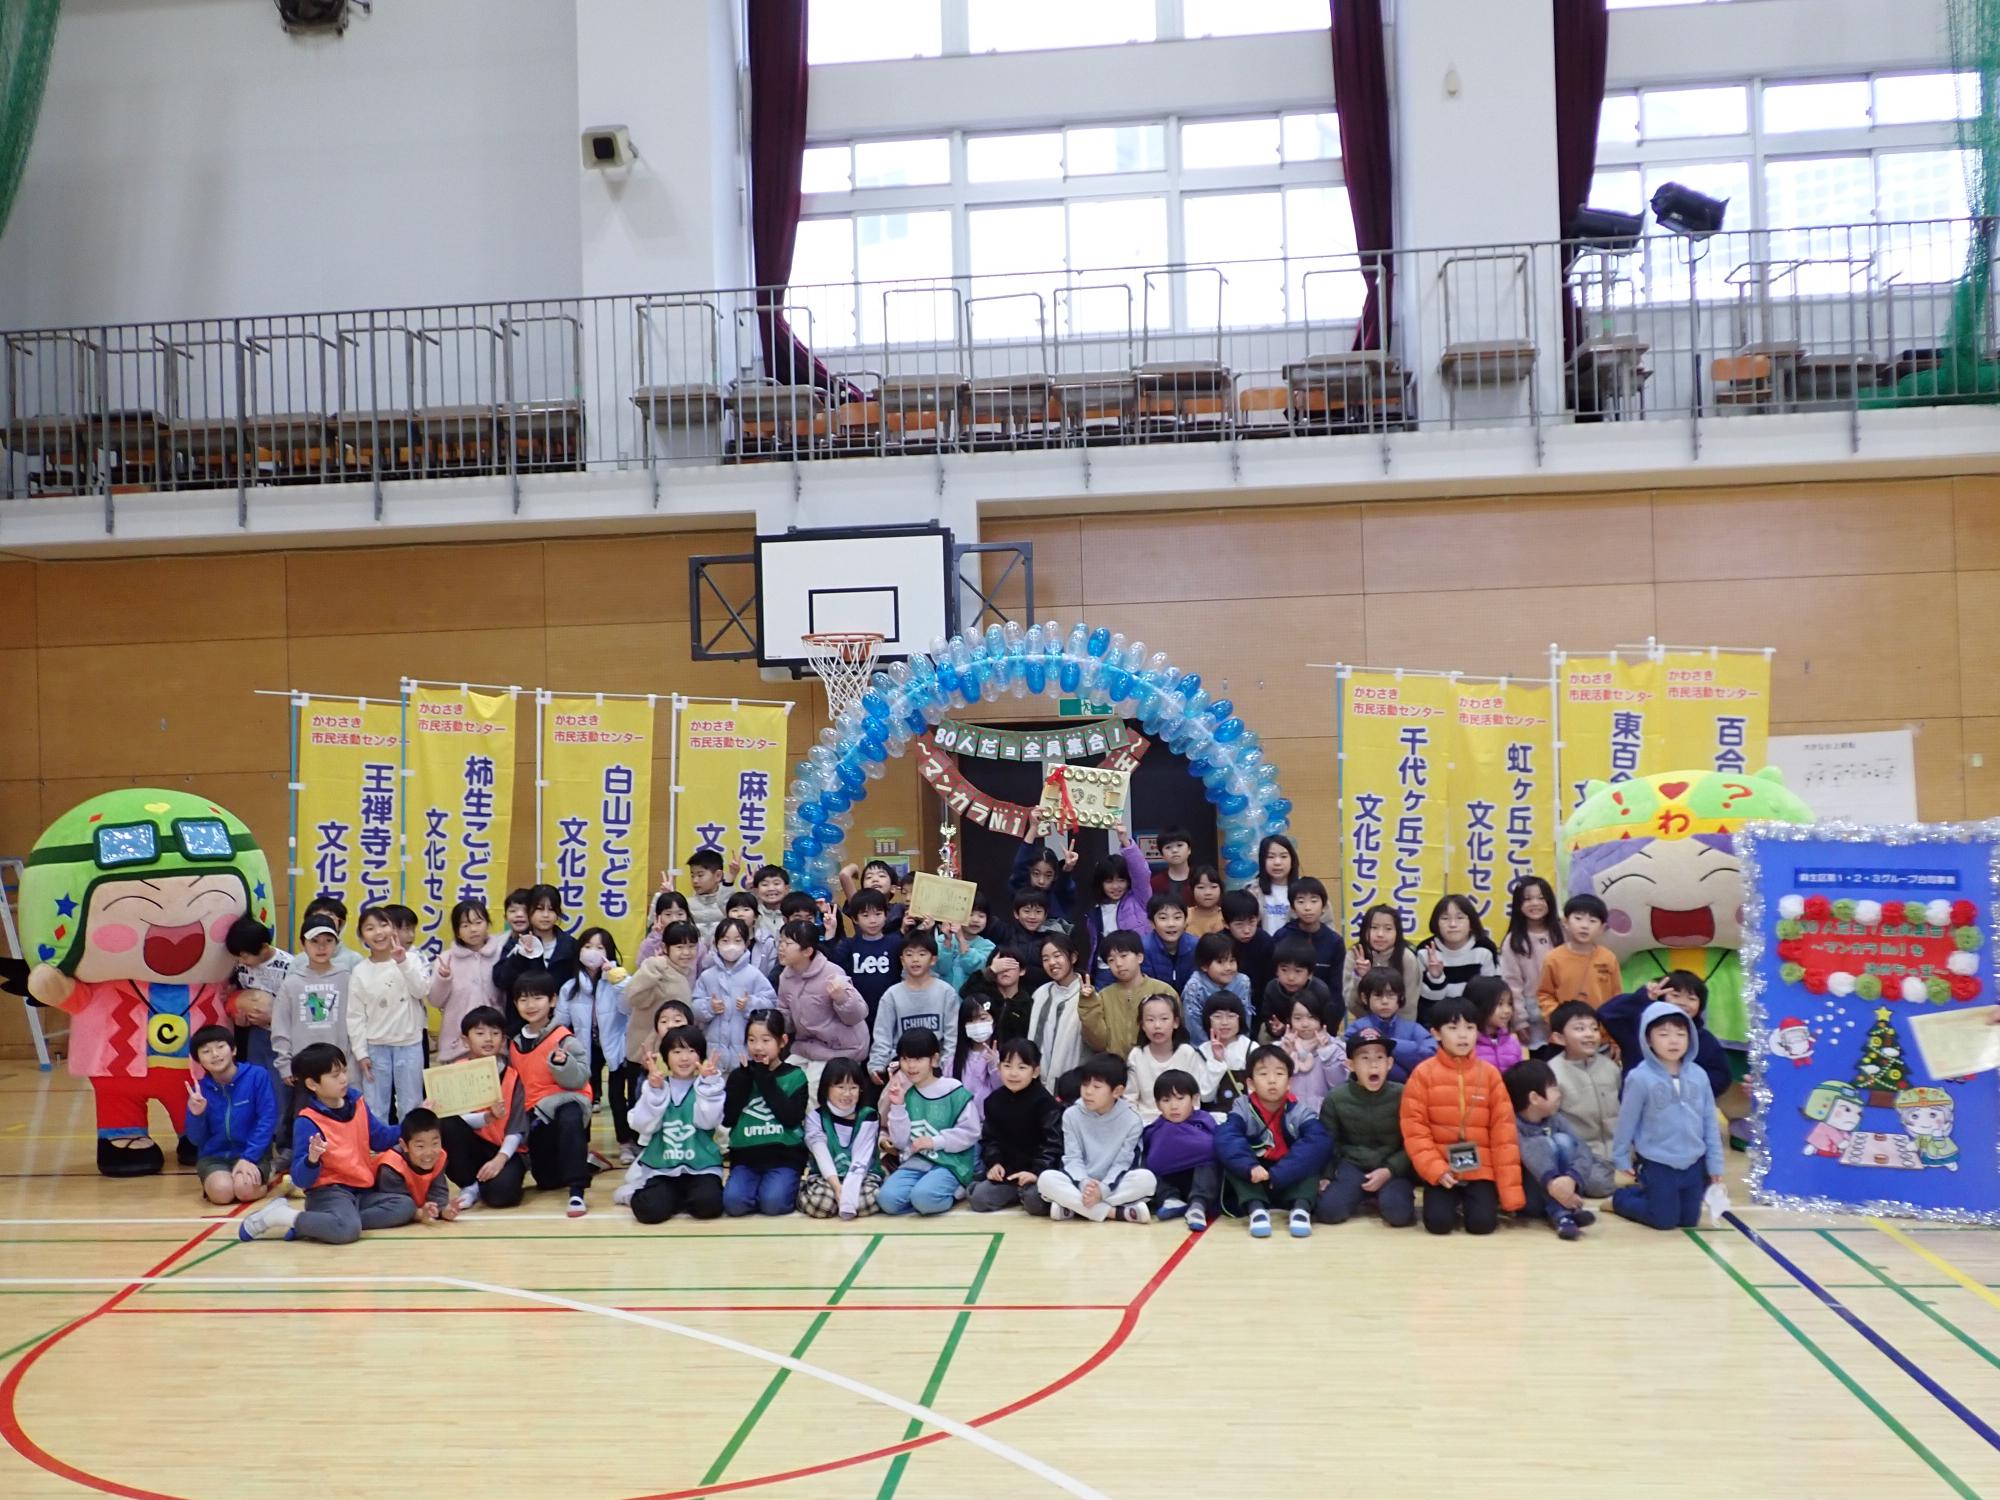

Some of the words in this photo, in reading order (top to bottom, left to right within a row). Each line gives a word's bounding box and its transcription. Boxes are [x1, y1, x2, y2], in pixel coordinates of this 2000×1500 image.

[1569, 673, 1613, 684] かわさき
[1669, 671, 1713, 681] かわさき
[1354, 687, 1398, 700] かわさき
[1668, 686, 1759, 699] 市民活動センター
[419, 703, 465, 715] かわさき
[1459, 698, 1504, 709] かわさき
[1353, 703, 1445, 718] 市民活動センター
[312, 716, 362, 729] かわさき
[555, 715, 599, 726] かわさき
[690, 720, 735, 732] かわさき
[1458, 713, 1548, 727] 市民活動センター
[417, 719, 506, 735] 市民活動センター
[311, 732, 410, 747] 市民活動センター
[554, 731, 644, 744] 市民活動センター
[690, 736, 778, 750] 市民活動センター
[1658, 810, 1691, 834] わ
[600, 764, 633, 918] 白山こども
[852, 952, 890, 974] Lee
